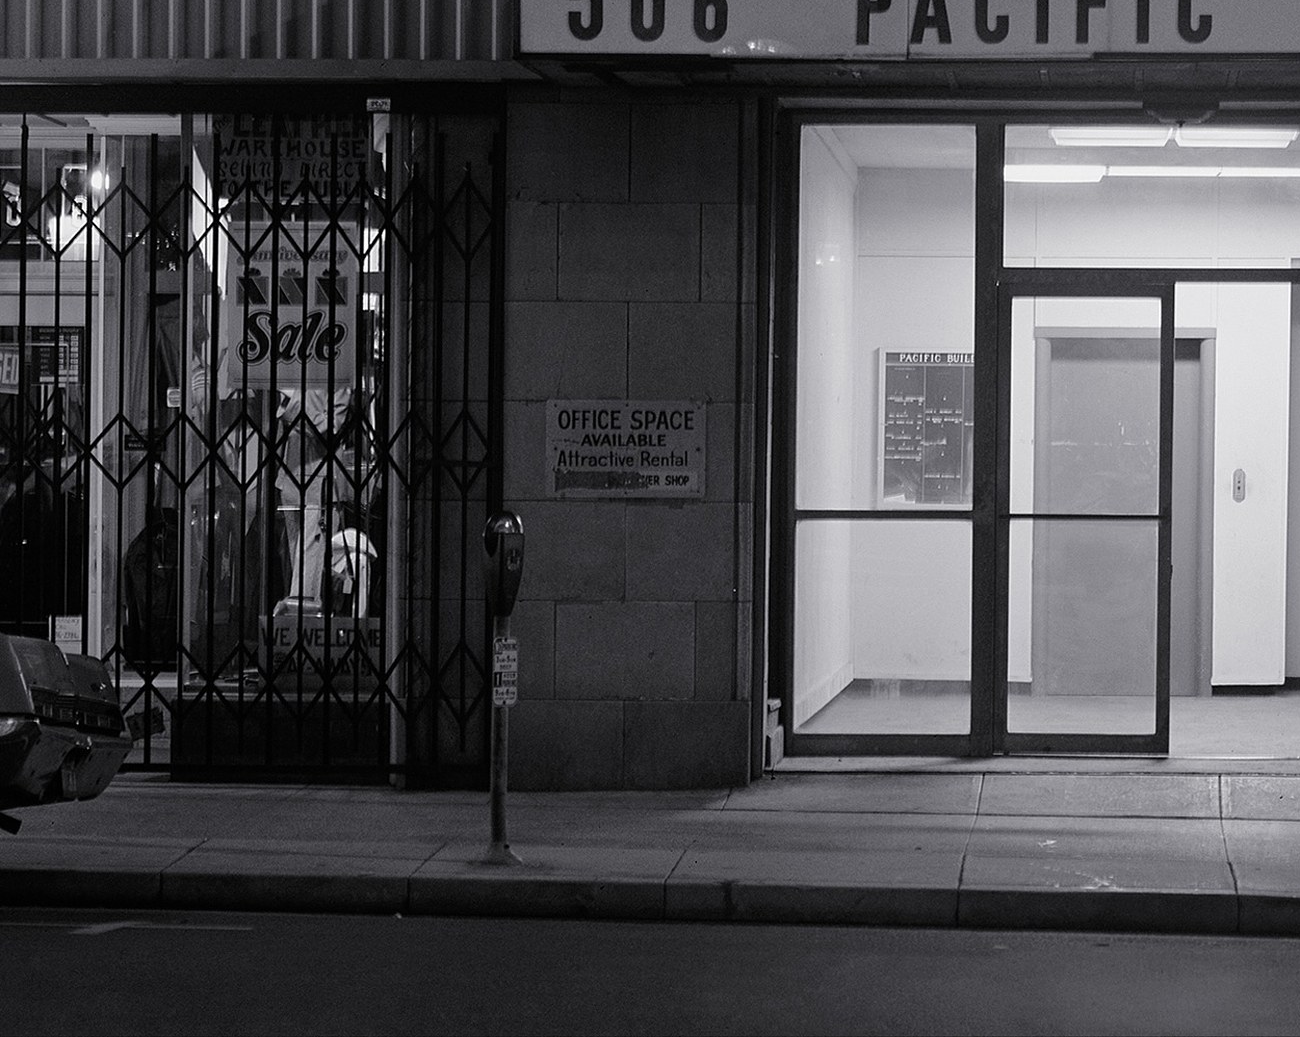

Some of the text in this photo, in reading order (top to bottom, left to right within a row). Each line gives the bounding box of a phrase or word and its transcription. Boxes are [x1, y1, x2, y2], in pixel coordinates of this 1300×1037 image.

[218, 138, 366, 158] WARHOUSE
[237, 311, 347, 363] Sale
[899, 353, 941, 363] PACIFIC
[558, 410, 695, 431] OFFICE SPACE
[581, 434, 667, 447] AVAILABLE
[558, 450, 688, 467] Attractive Rental
[665, 475, 690, 486] SHOP
